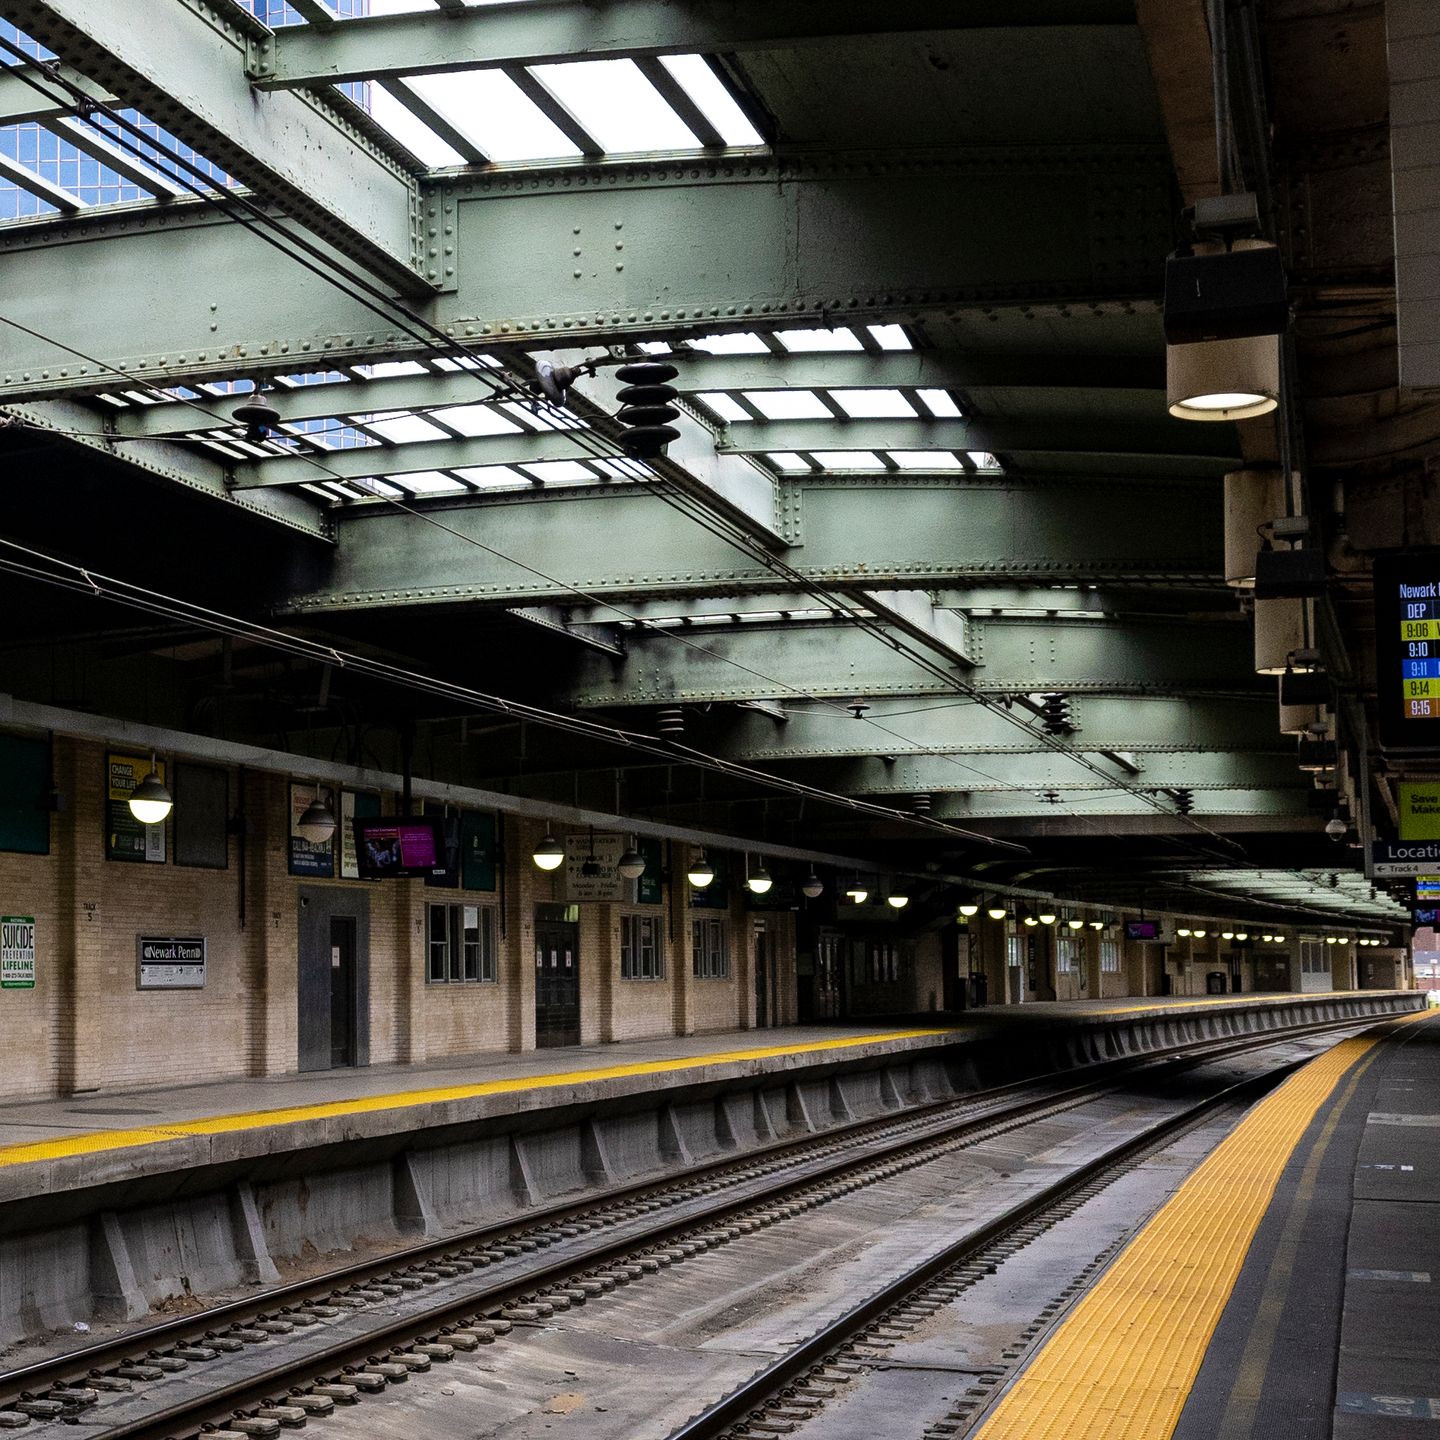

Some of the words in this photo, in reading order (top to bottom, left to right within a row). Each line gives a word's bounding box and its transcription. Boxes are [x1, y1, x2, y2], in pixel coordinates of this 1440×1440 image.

[1400, 582, 1436, 598] Newark
[1408, 603, 1426, 619] DEP
[1407, 622, 1429, 638] 9:06
[1409, 642, 1428, 657] 9:10
[1411, 661, 1427, 677] 9:11
[1411, 681, 1429, 696] 9:14
[1411, 700, 1430, 716] 9:15
[1411, 794, 1438, 804] Save
[1388, 844, 1440, 858] Locati
[1390, 864, 1413, 872] Track
[1413, 864, 1418, 872] 4
[87, 912, 93, 922] 5
[2, 925, 34, 949] SUICIDE
[2, 950, 34, 960] PREVENTION
[149, 944, 177, 959] Newark
[178, 945, 196, 959] Penn
[2, 961, 34, 970] LIFELINE
